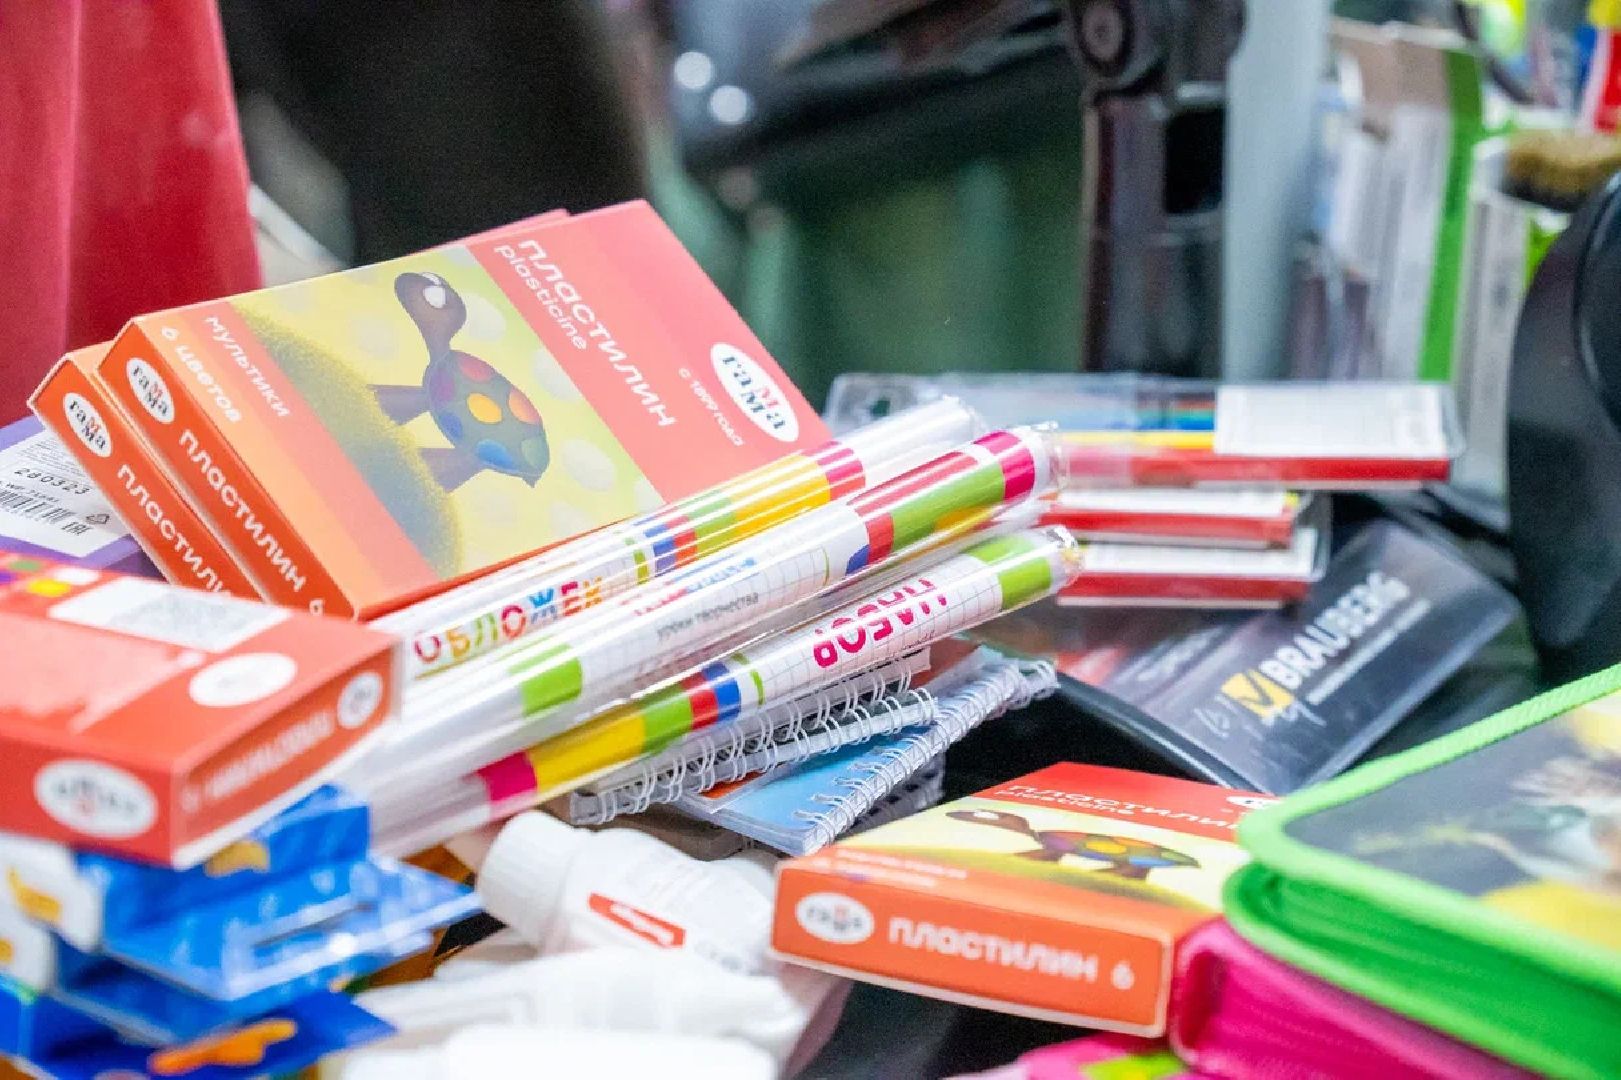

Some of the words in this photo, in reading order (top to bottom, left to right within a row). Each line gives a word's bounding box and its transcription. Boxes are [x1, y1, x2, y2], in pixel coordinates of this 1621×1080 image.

[494, 245, 587, 350] plasticine
[162, 327, 178, 341] 6
[1110, 961, 1136, 990] 6
